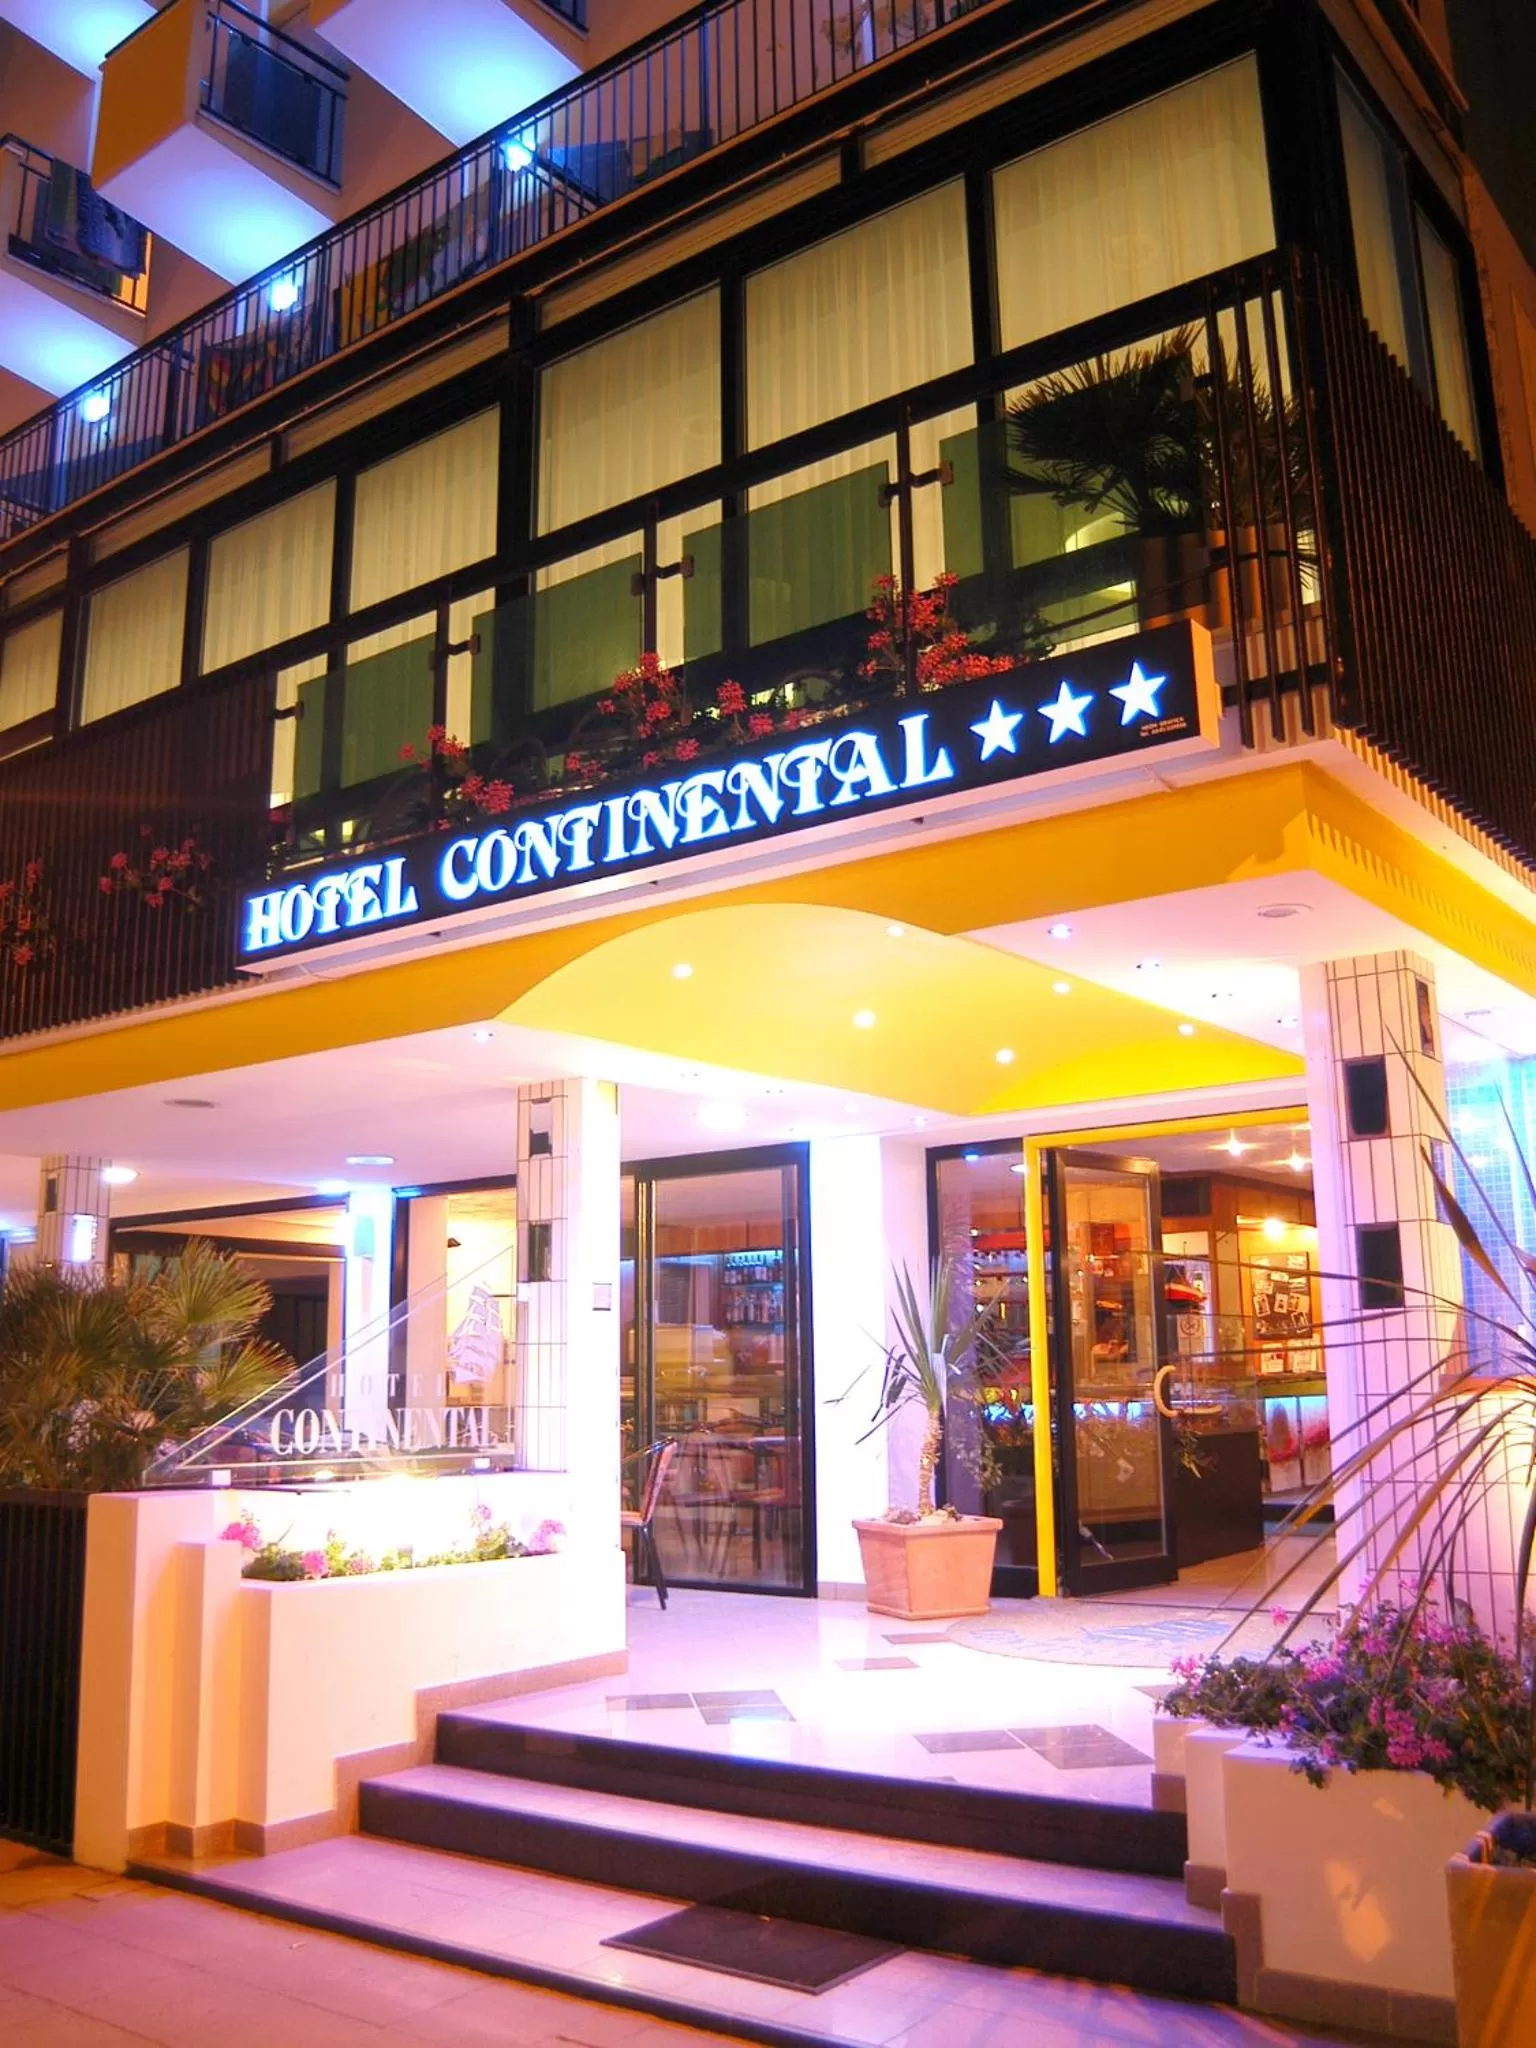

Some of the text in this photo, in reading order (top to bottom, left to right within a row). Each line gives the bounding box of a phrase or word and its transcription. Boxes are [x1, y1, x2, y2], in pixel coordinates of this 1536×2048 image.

[246, 713, 955, 952] HOTEL CONTINENTAL
[330, 1373, 447, 1397] HOTEL
